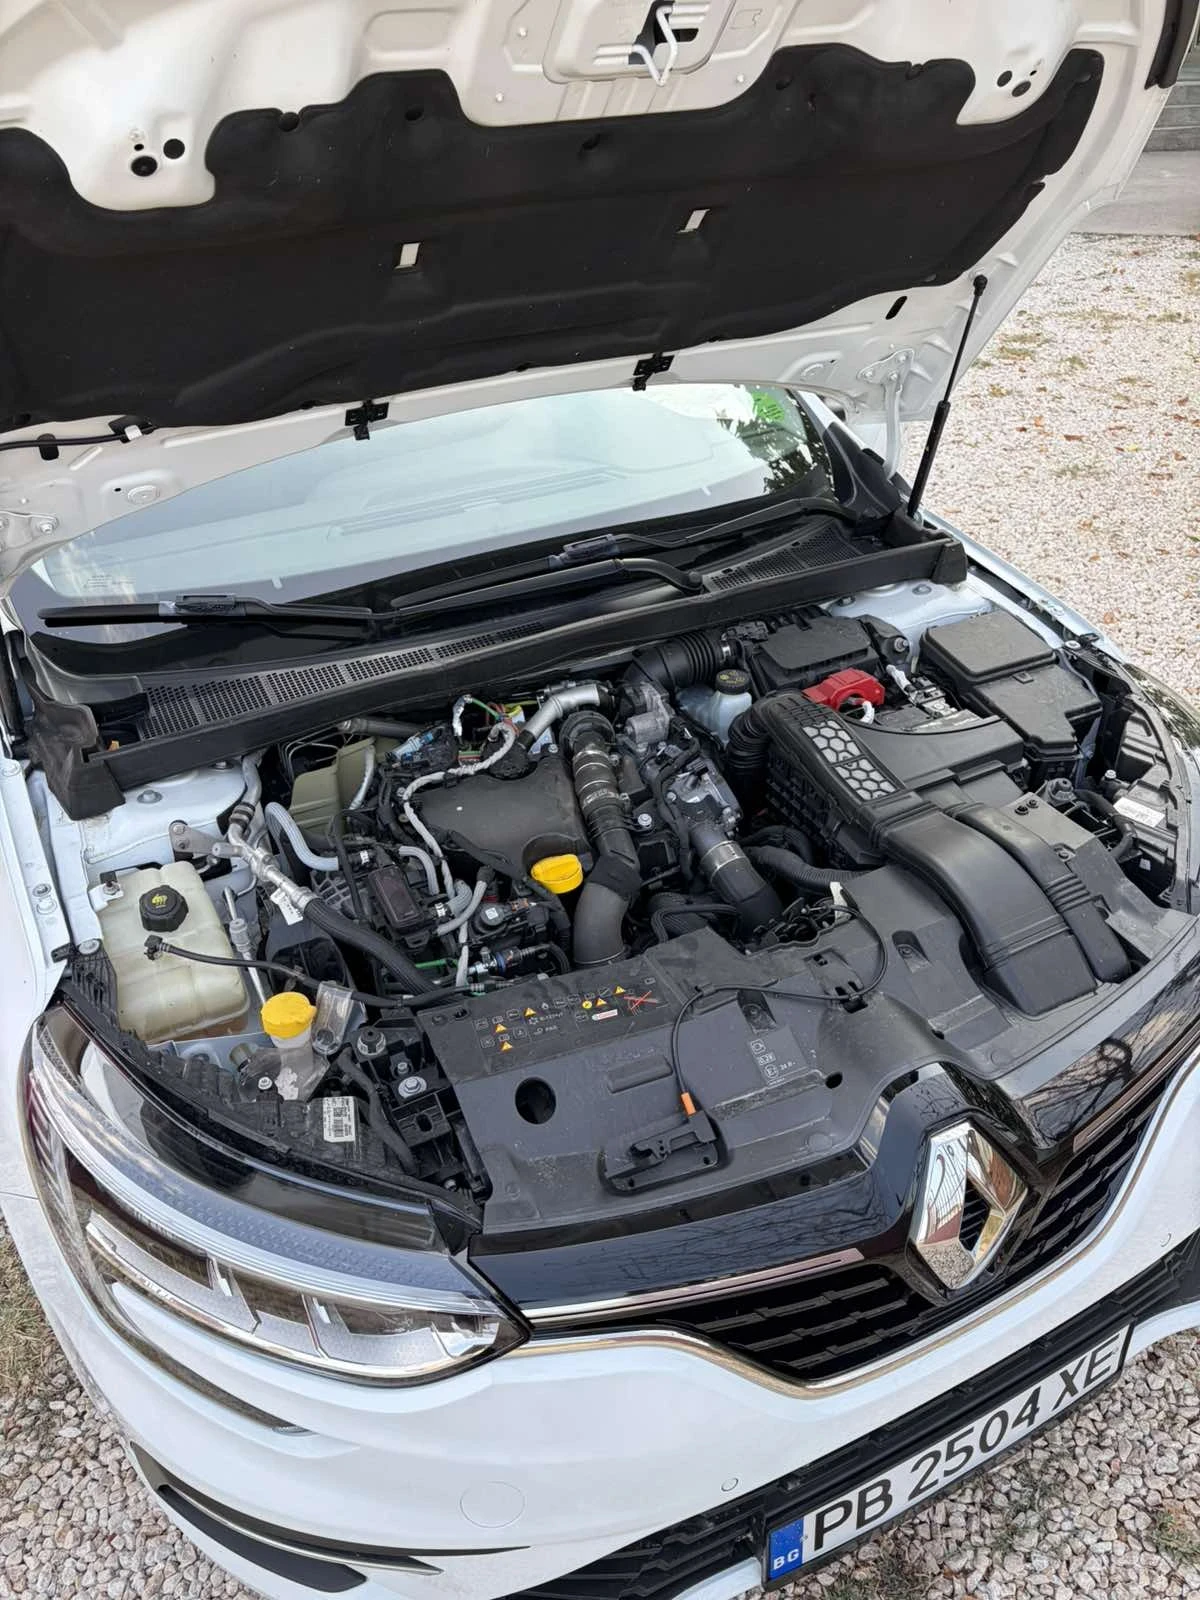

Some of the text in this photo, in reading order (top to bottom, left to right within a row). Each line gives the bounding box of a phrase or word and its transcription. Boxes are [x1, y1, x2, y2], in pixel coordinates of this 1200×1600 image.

[813, 1334, 1120, 1551] PB 2504 XE
[773, 1548, 799, 1570] BG
